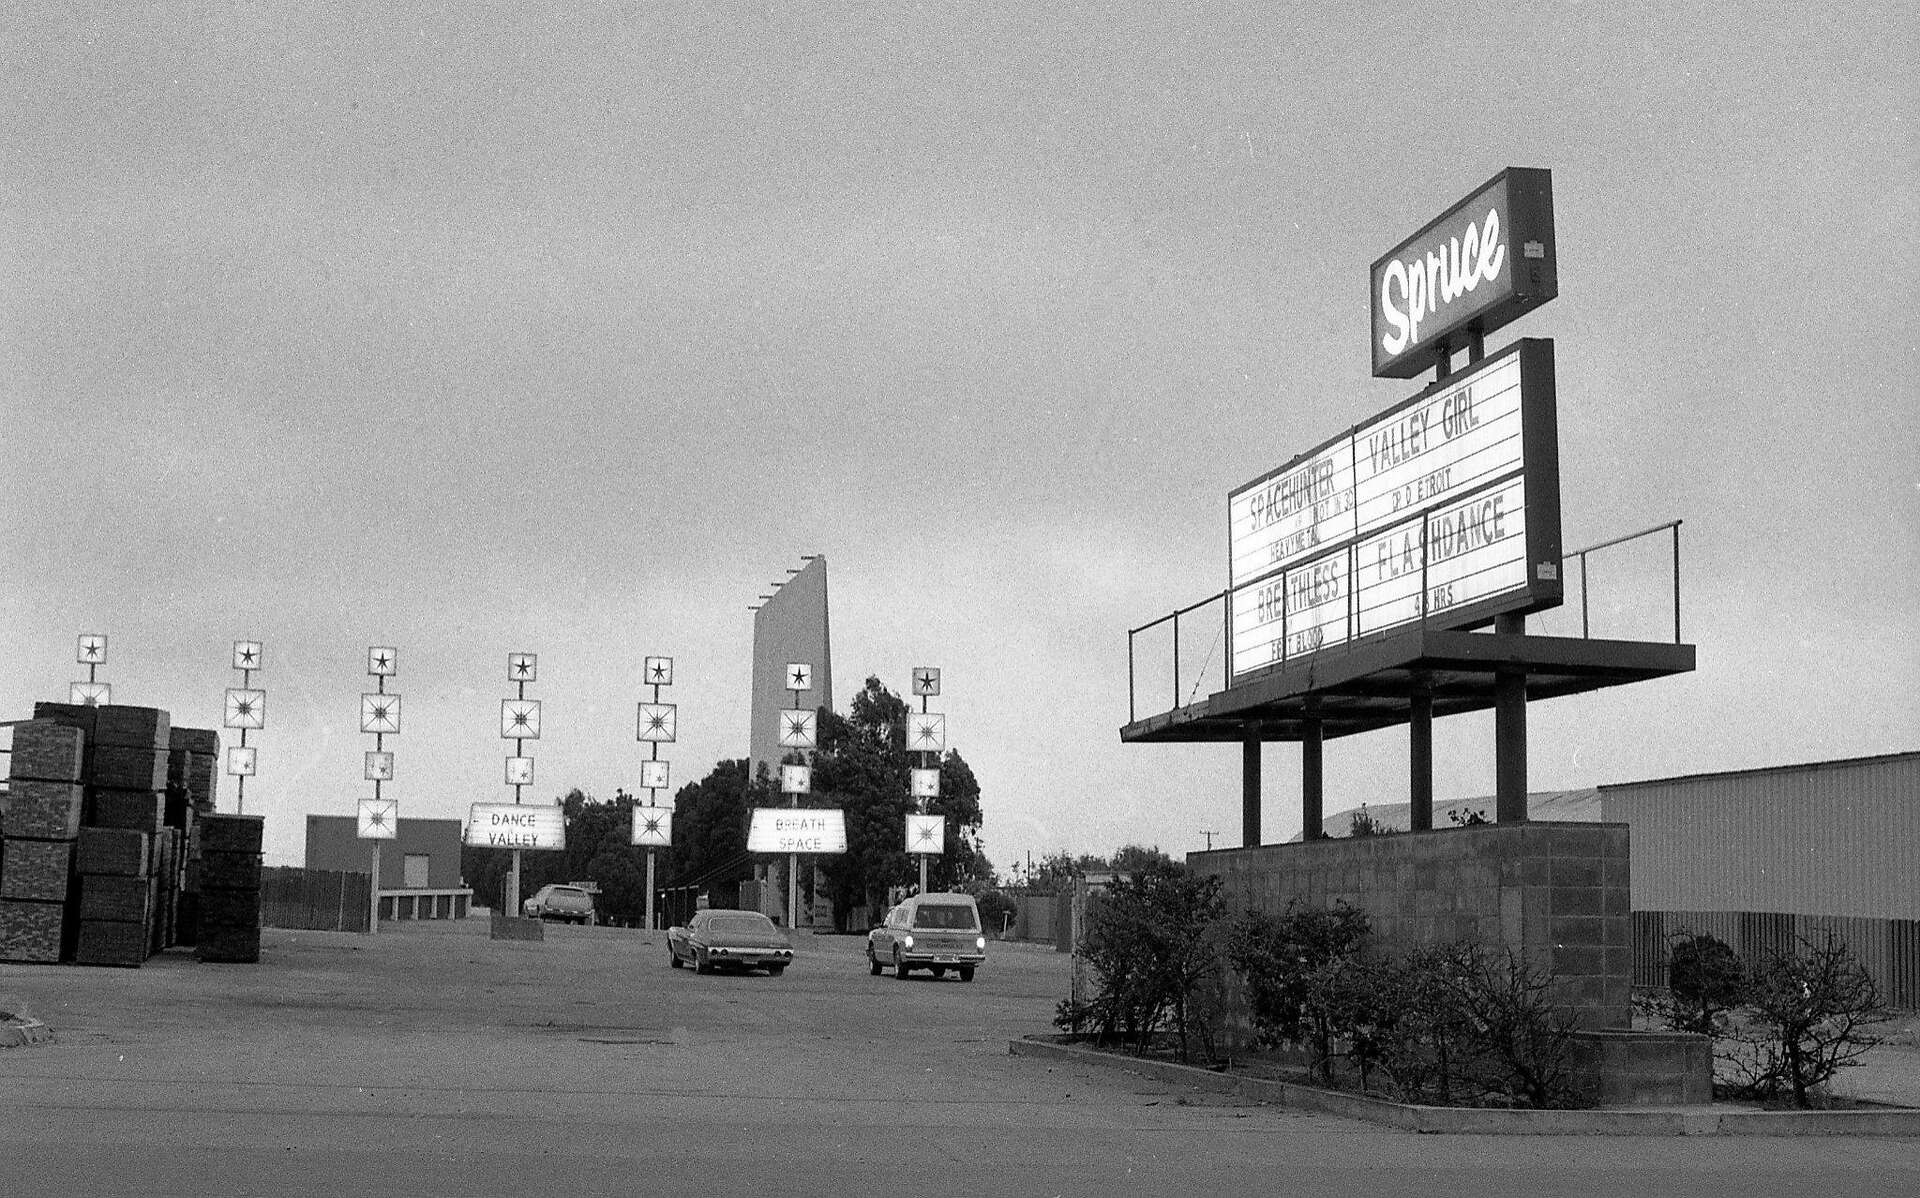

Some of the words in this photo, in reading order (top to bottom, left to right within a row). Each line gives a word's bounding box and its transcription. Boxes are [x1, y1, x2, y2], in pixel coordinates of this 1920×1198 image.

[1382, 207, 1505, 355] Spruce
[1369, 408, 1430, 474] VALLEY
[1442, 386, 1480, 440] GIRL
[1250, 458, 1335, 531] SPACEHUNTER
[1257, 560, 1339, 624] BRETHLESS
[1433, 584, 1454, 610] HRS
[491, 813, 536, 827] DANCE
[776, 819, 825, 831] BREATH
[489, 832, 538, 847] VALLEY
[779, 838, 821, 850] SPACE
